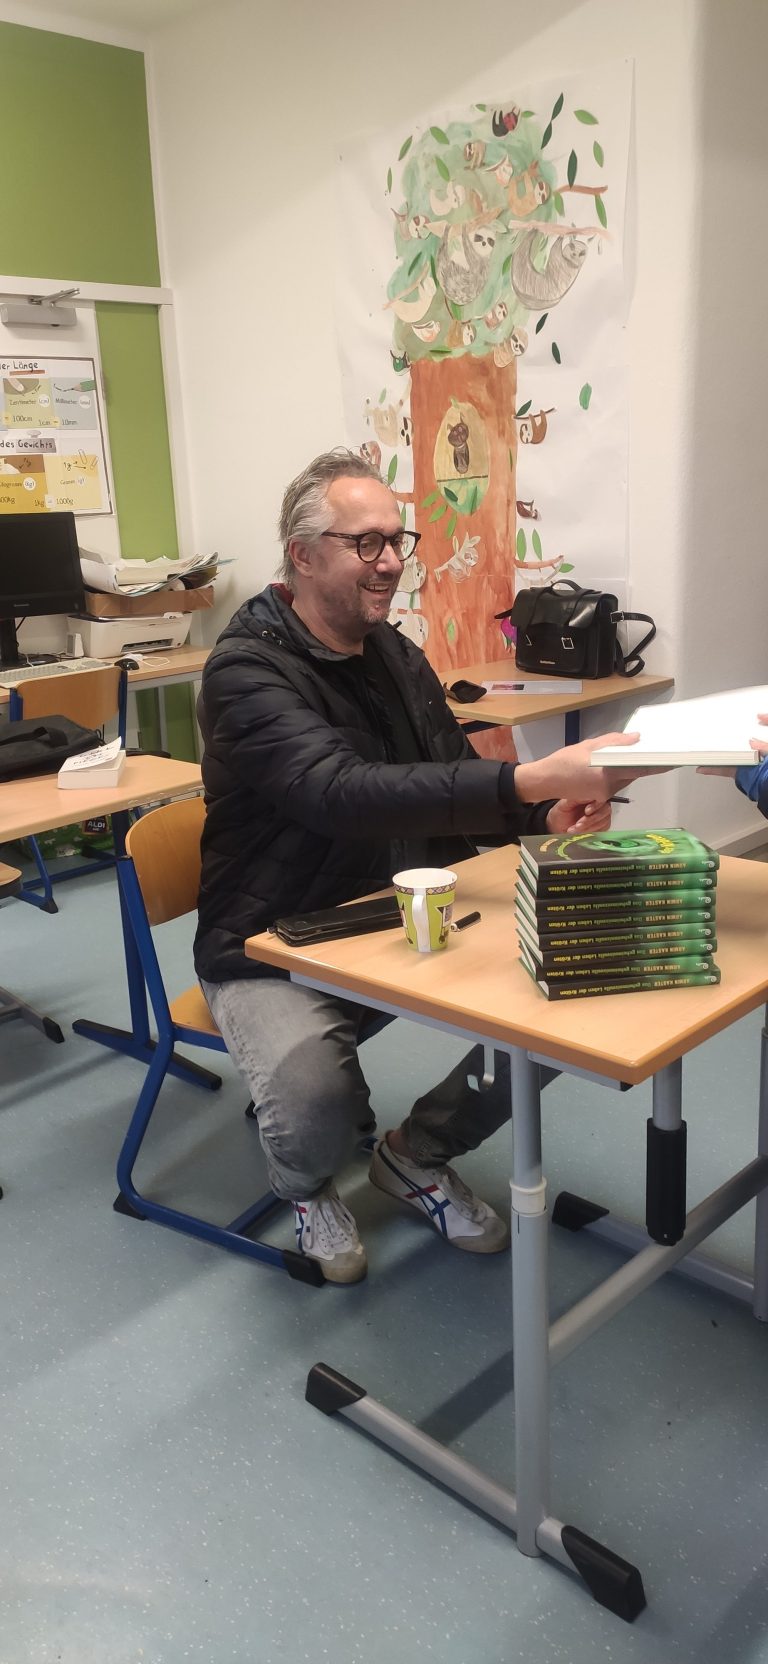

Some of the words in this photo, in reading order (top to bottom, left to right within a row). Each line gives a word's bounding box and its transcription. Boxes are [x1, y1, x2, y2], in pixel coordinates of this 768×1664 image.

[13, 361, 39, 372] Länge
[17, 439, 53, 449] Gewichts
[647, 932, 666, 940] KASTER
[649, 947, 669, 955] KASTER
[654, 980, 673, 988] KASTER
